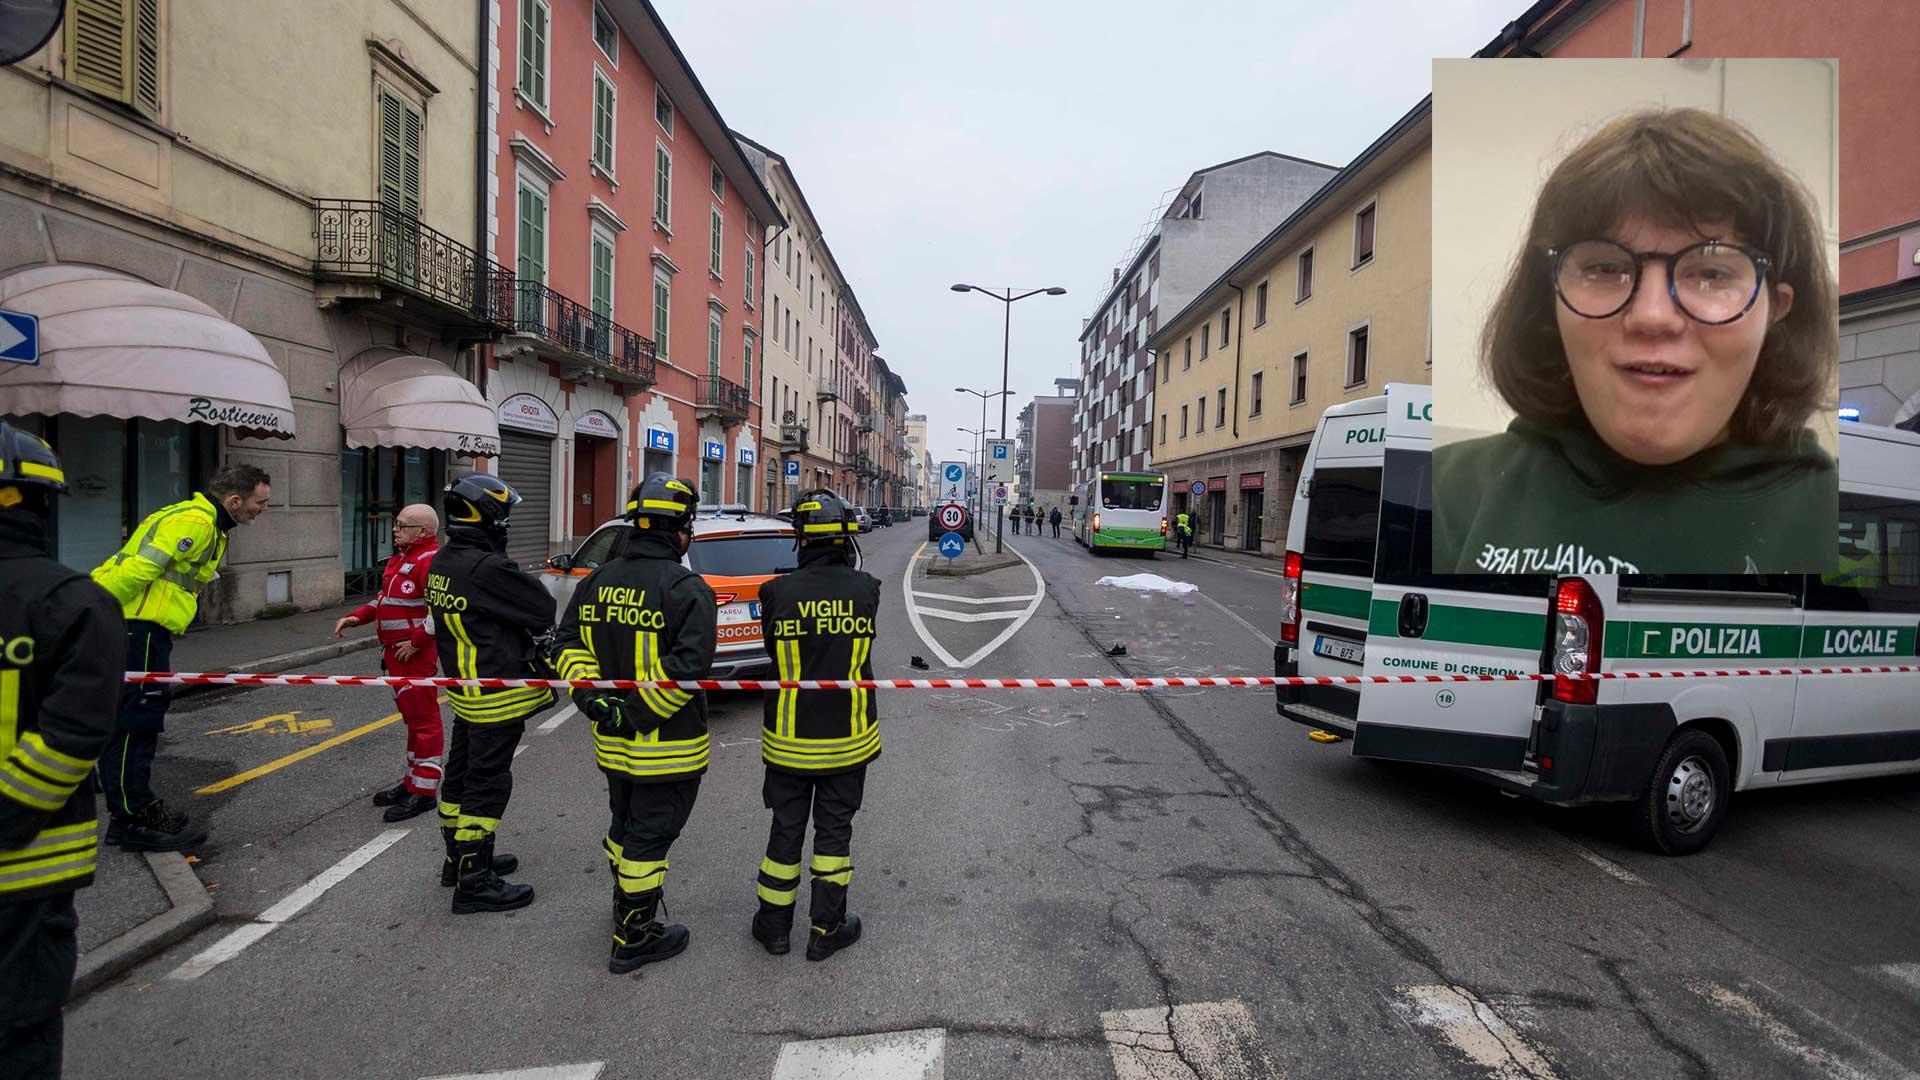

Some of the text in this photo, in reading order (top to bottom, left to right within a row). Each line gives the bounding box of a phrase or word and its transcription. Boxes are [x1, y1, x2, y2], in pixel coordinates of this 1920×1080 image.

[188, 397, 279, 427] Rosticceria
[1345, 427, 1386, 444] POLI
[995, 446, 1004, 458] P
[788, 462, 797, 474] P
[946, 511, 959, 522] 30
[598, 586, 646, 607] VIGILI
[606, 605, 665, 630] FUOCO
[798, 600, 853, 618] VIGILI
[1669, 628, 1897, 654] POLIZIA LOCALE
[1382, 657, 1438, 671] COMUNE
[1444, 663, 1457, 673] DI
[1439, 695, 1453, 703] 18
